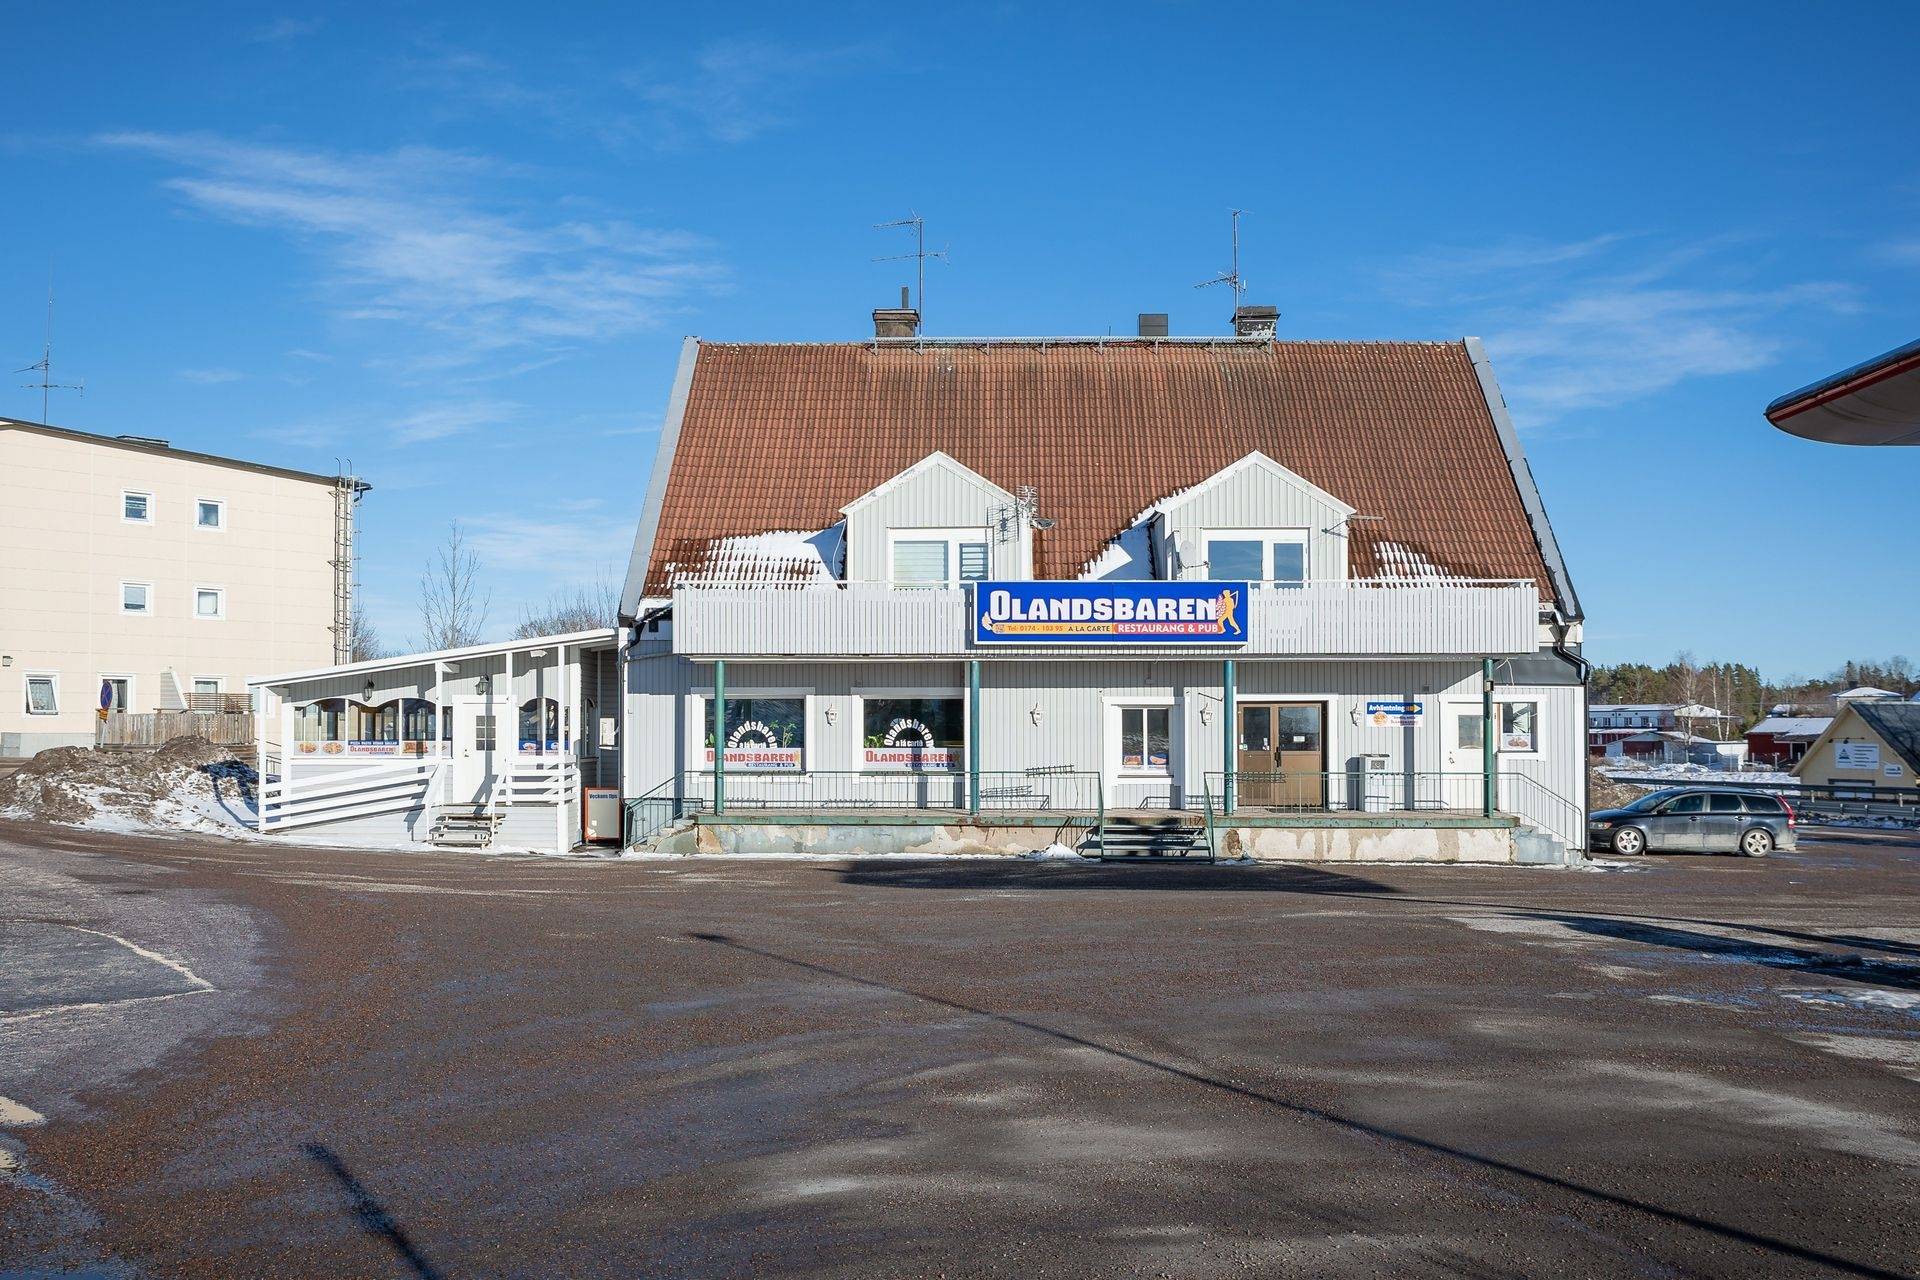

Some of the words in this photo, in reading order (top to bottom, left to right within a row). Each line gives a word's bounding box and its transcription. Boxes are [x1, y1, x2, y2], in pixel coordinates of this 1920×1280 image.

[989, 590, 1217, 621] OLANDSBAREN
[1118, 623, 1185, 633] RESTAURANG
[1187, 624, 1195, 633] &
[1198, 624, 1218, 633] PUB
[706, 750, 794, 762] OANDSBAREN
[866, 750, 952, 763] OLANDSBAREN
